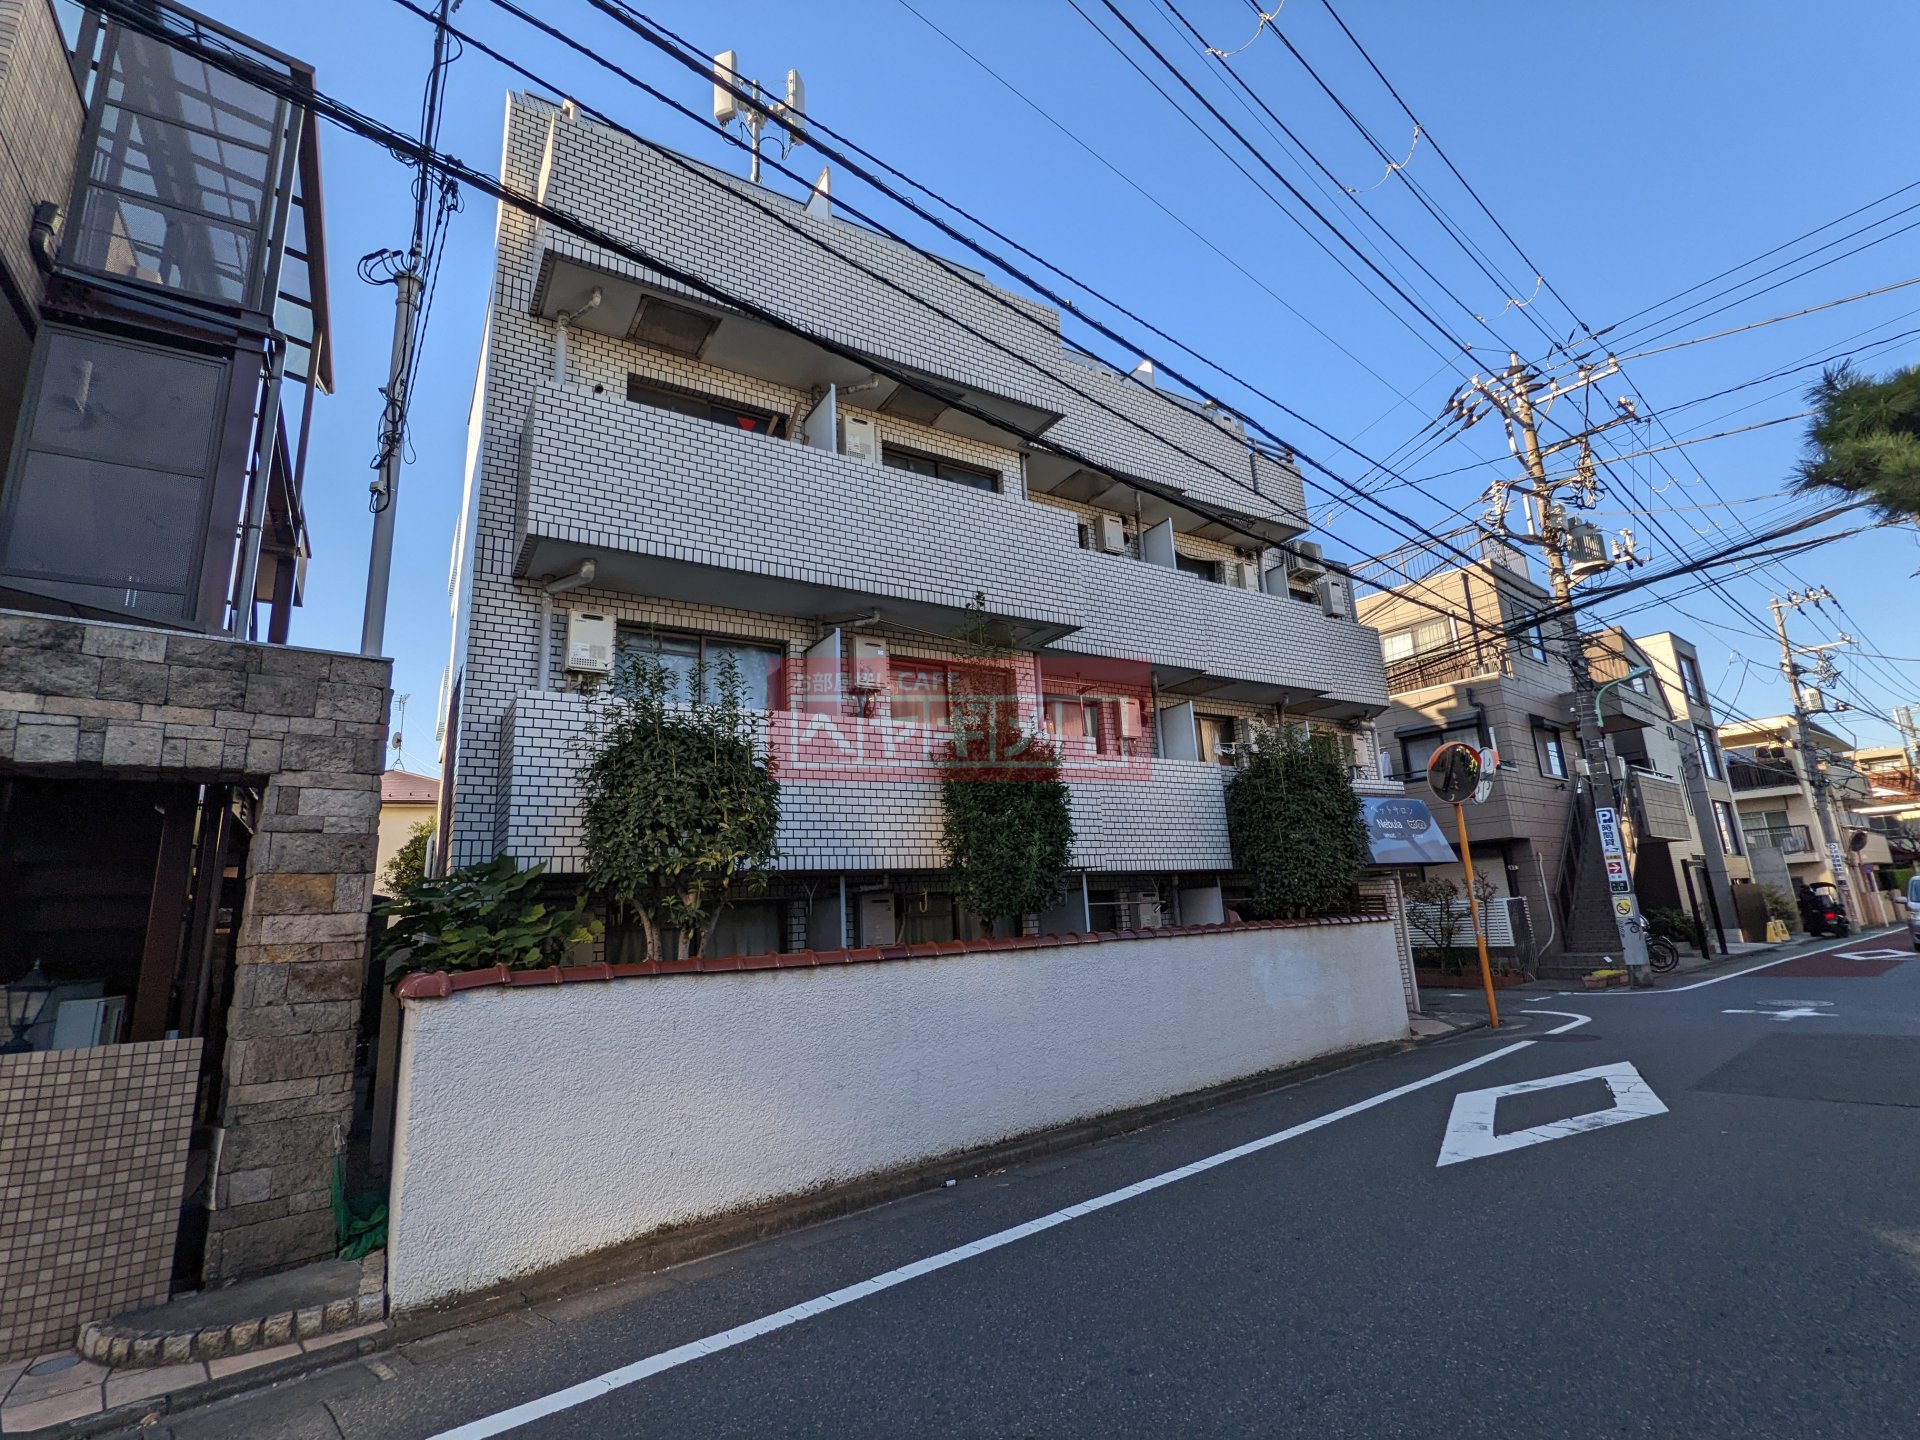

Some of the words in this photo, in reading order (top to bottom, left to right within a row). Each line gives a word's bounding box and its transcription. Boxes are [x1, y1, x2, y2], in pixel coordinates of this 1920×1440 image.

[1376, 818, 1403, 829] Nebula
[1598, 811, 1611, 824] P
[1601, 824, 1615, 847] 時間貸
